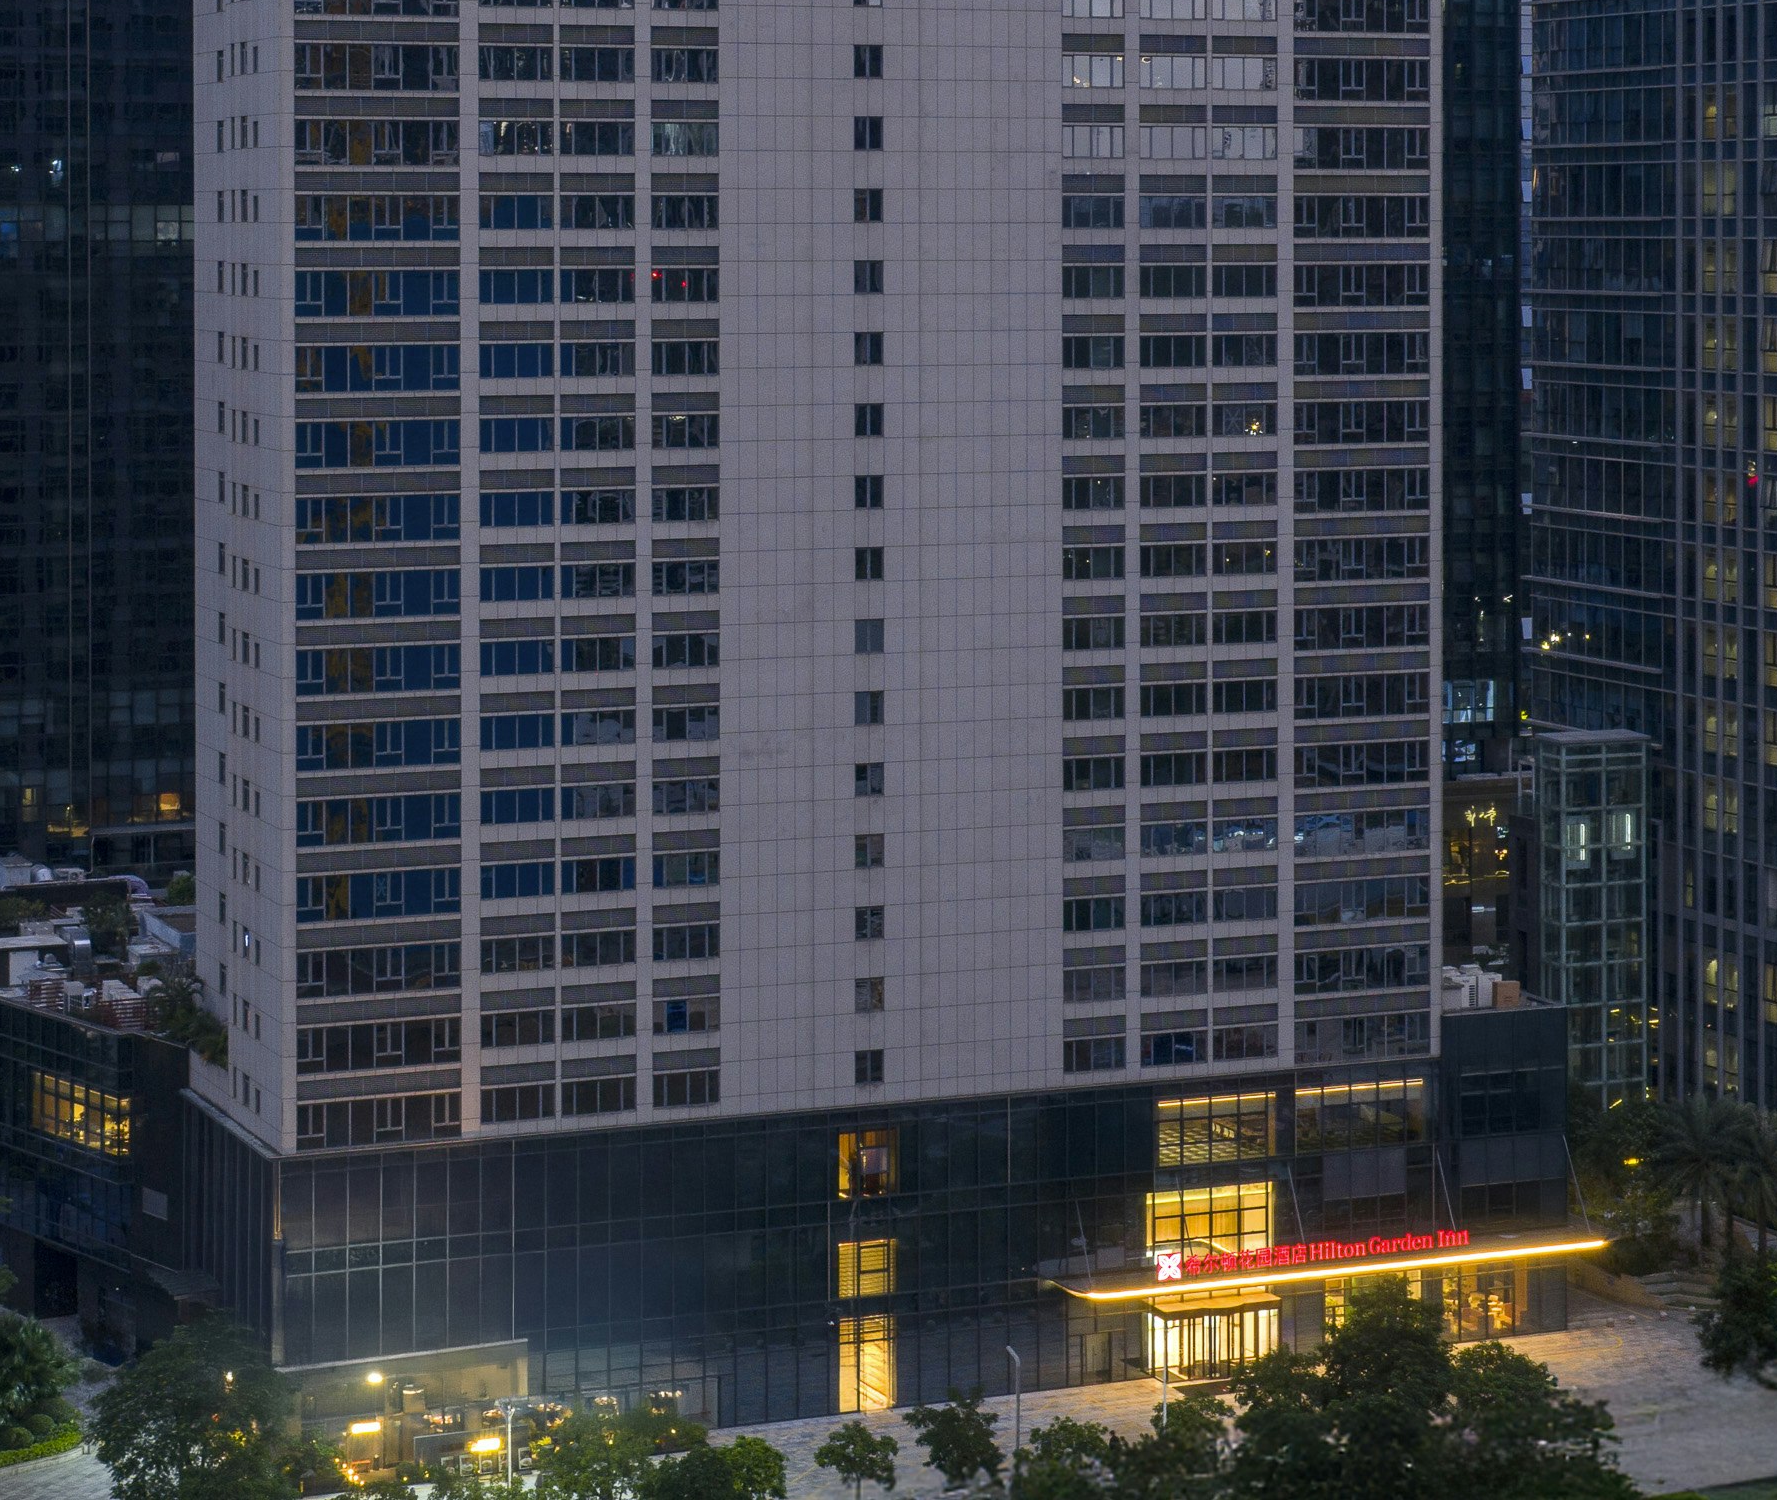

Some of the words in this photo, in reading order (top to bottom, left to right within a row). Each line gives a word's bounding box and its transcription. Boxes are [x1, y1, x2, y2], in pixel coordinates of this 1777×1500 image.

[1185, 1243, 1308, 1275] 希尔顿花园酒店
[1309, 1240, 1366, 1261] Hilton
[1368, 1232, 1434, 1255] Garden
[1437, 1230, 1470, 1248] Inn
